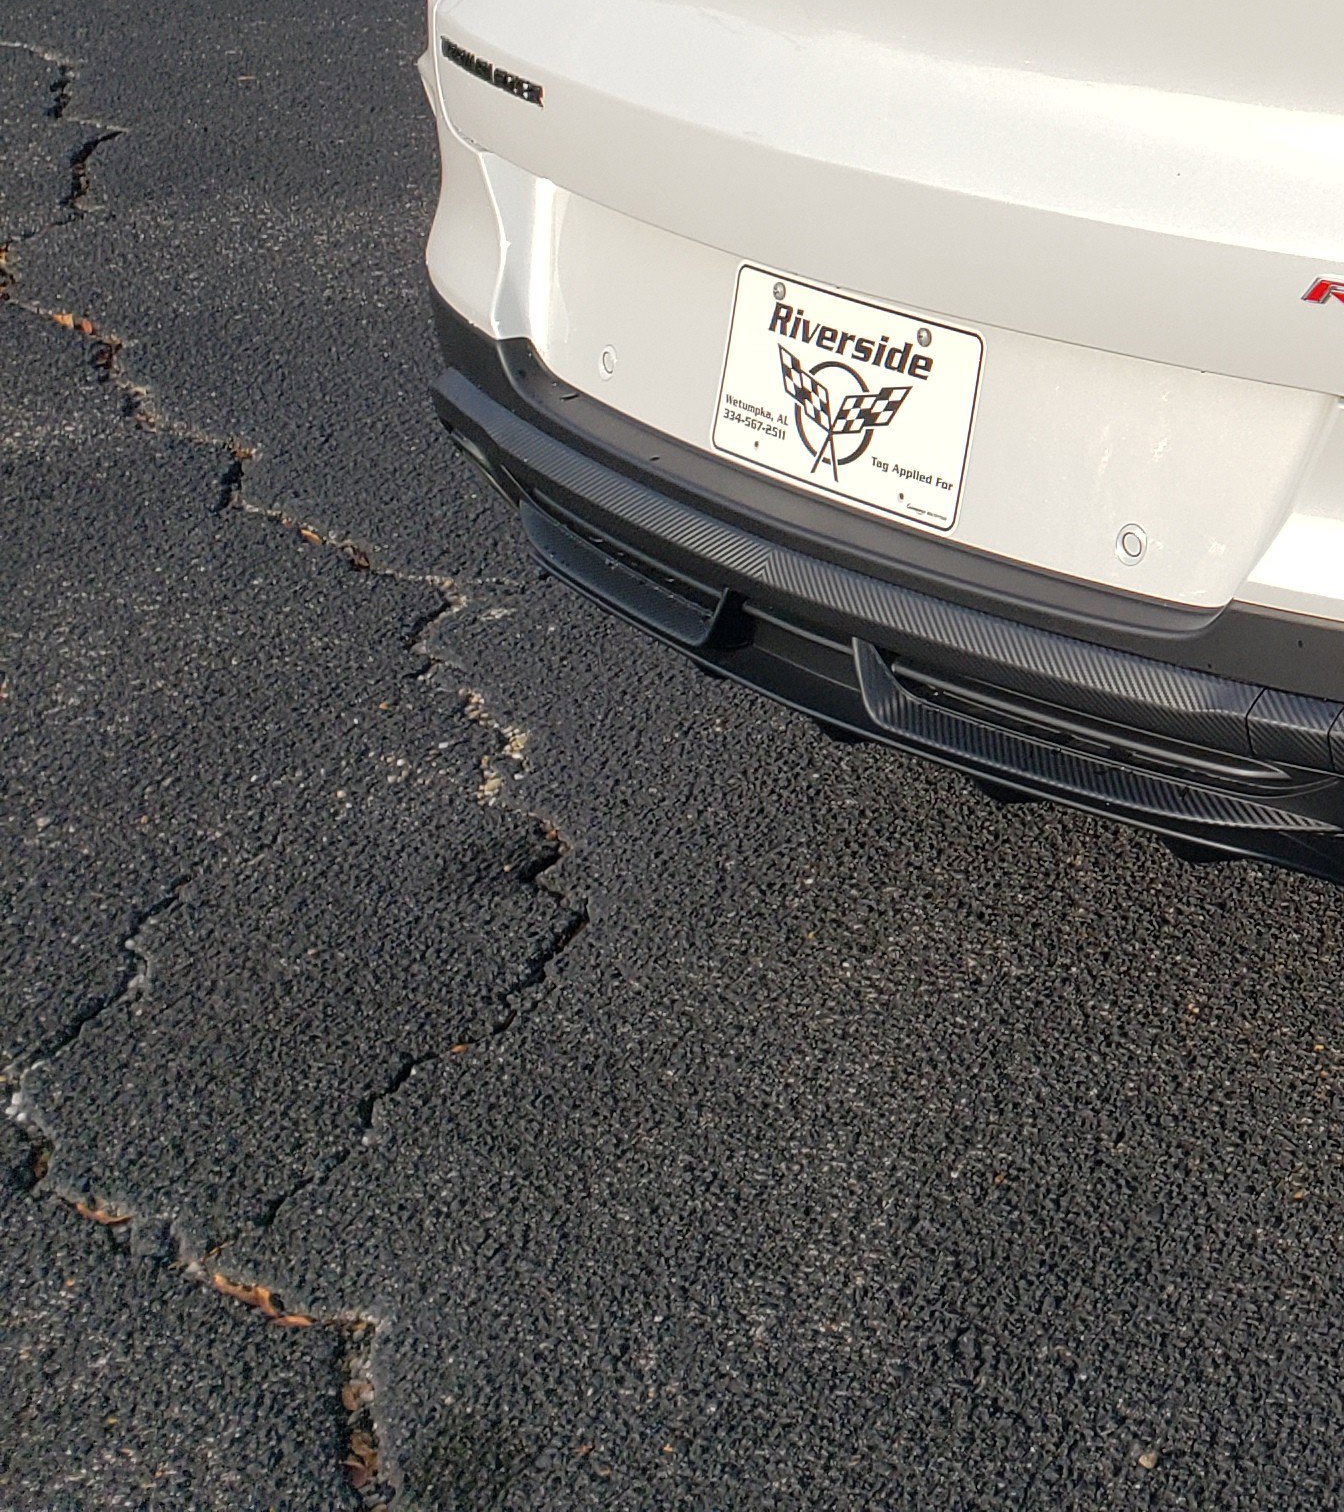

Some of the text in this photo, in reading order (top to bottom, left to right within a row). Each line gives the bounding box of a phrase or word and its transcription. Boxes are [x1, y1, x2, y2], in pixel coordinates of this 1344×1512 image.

[768, 301, 934, 381] Riverside
[723, 407, 786, 441] 334-567-2511
[725, 393, 789, 426] Wetumpka, AL
[871, 456, 954, 491] Tag Applied For
